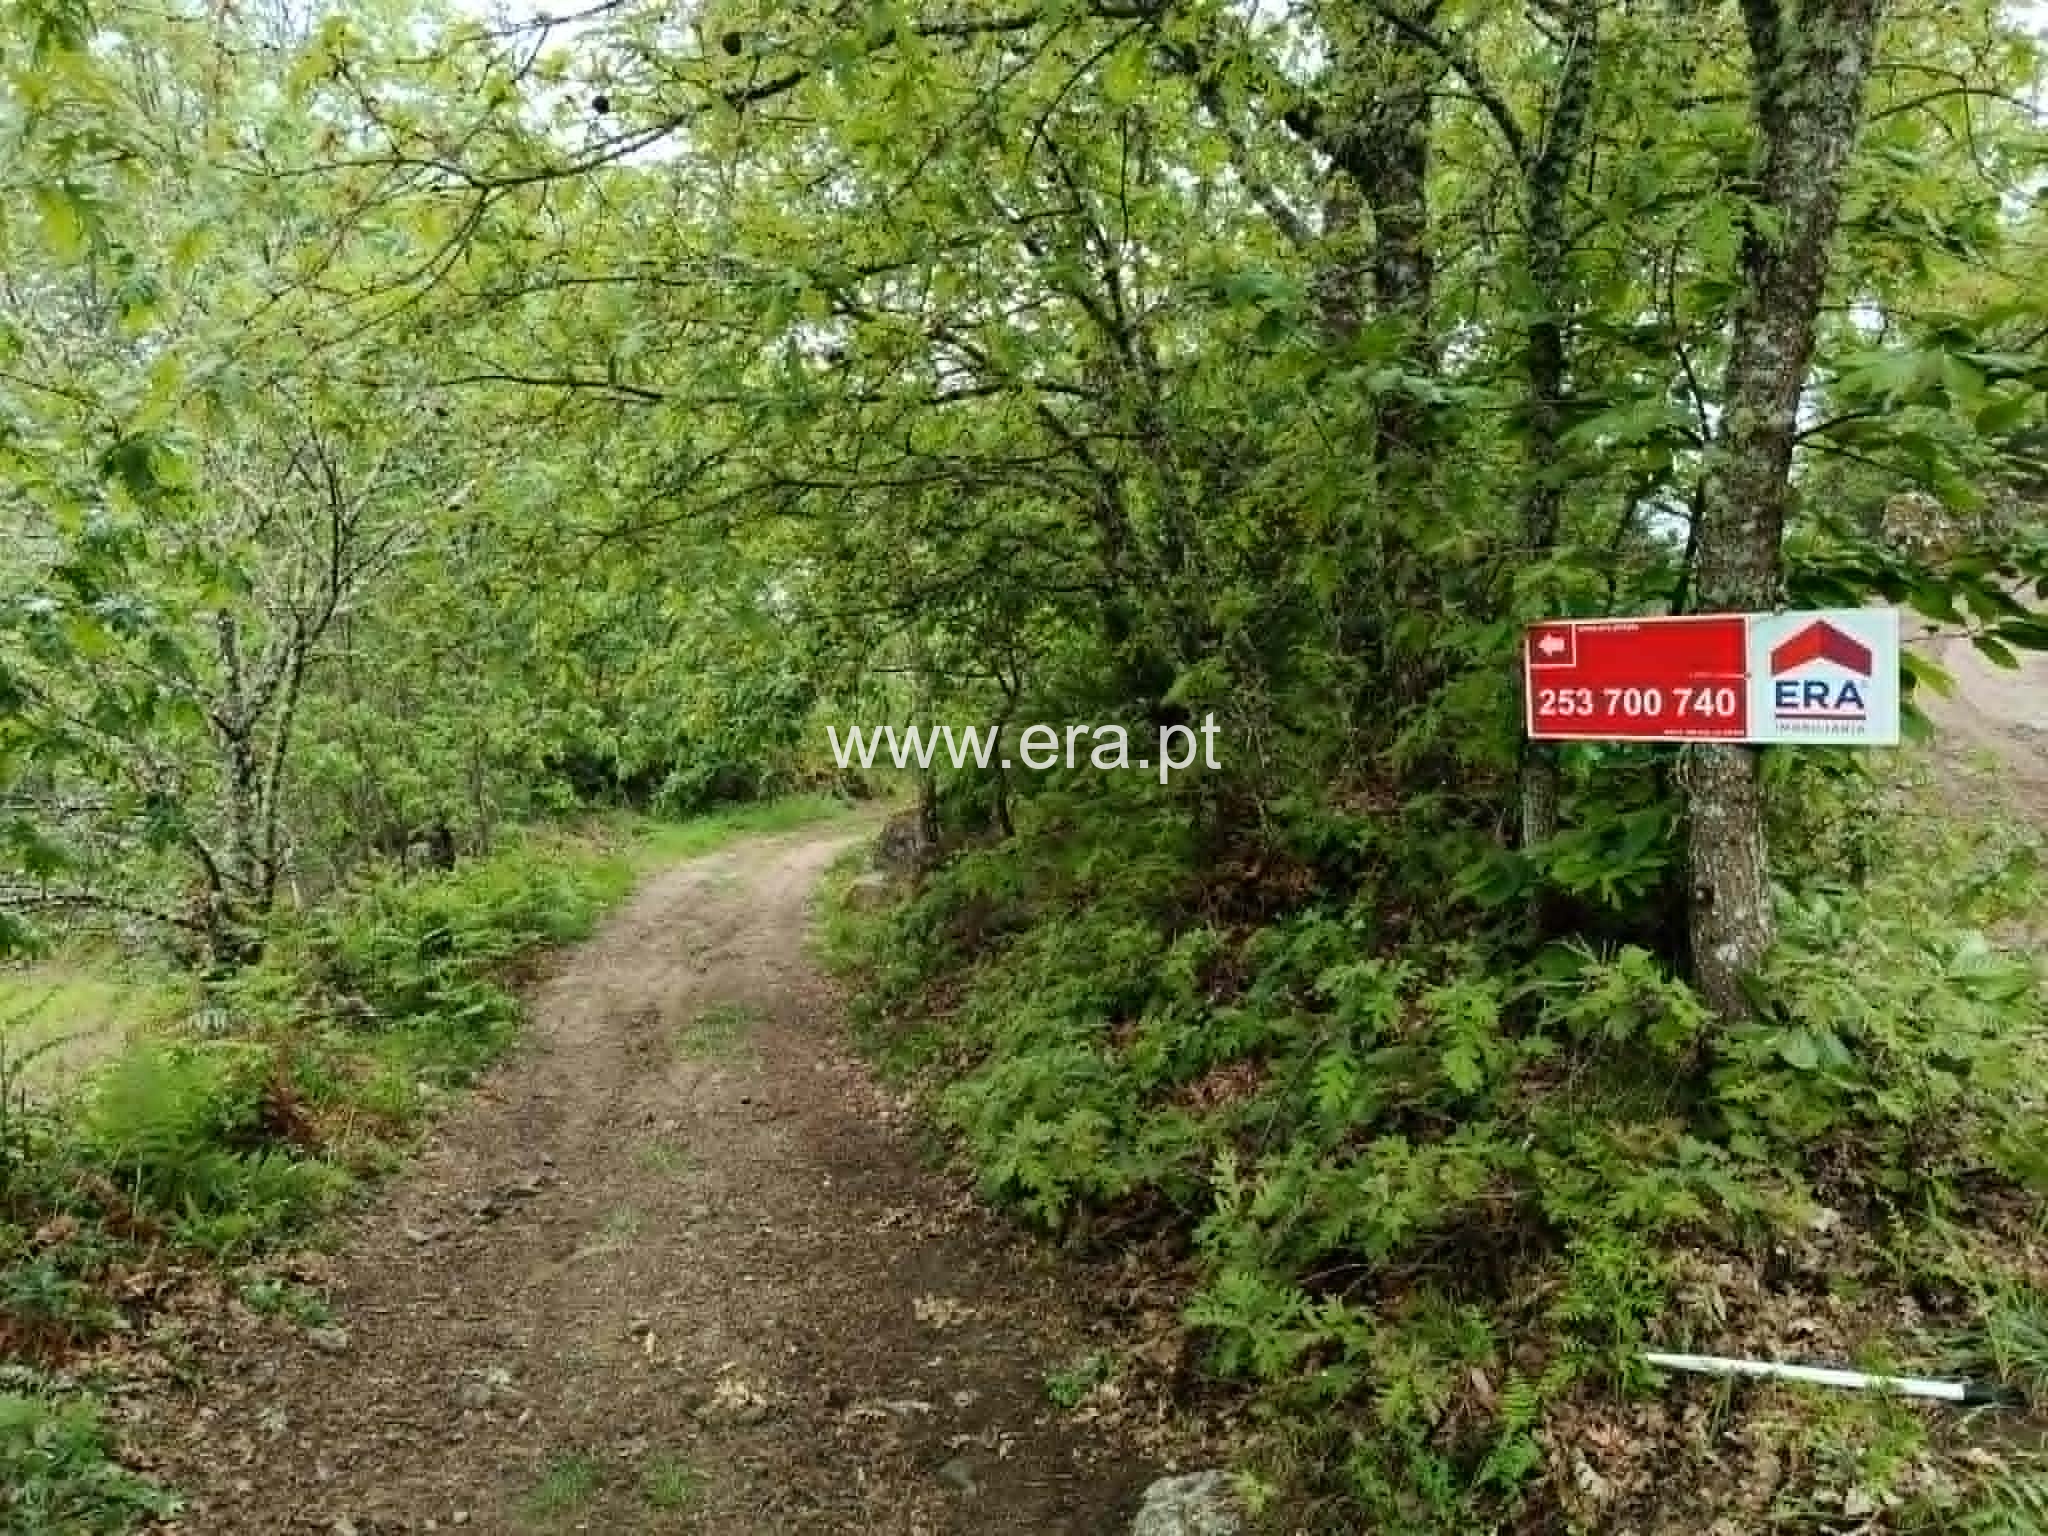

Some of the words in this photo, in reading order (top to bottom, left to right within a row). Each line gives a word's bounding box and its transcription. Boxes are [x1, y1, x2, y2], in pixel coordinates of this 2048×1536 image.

[1539, 688, 1593, 717] 253
[1604, 688, 1662, 717] 700
[1672, 687, 1736, 718] 740
[1776, 680, 1864, 709] ERA
